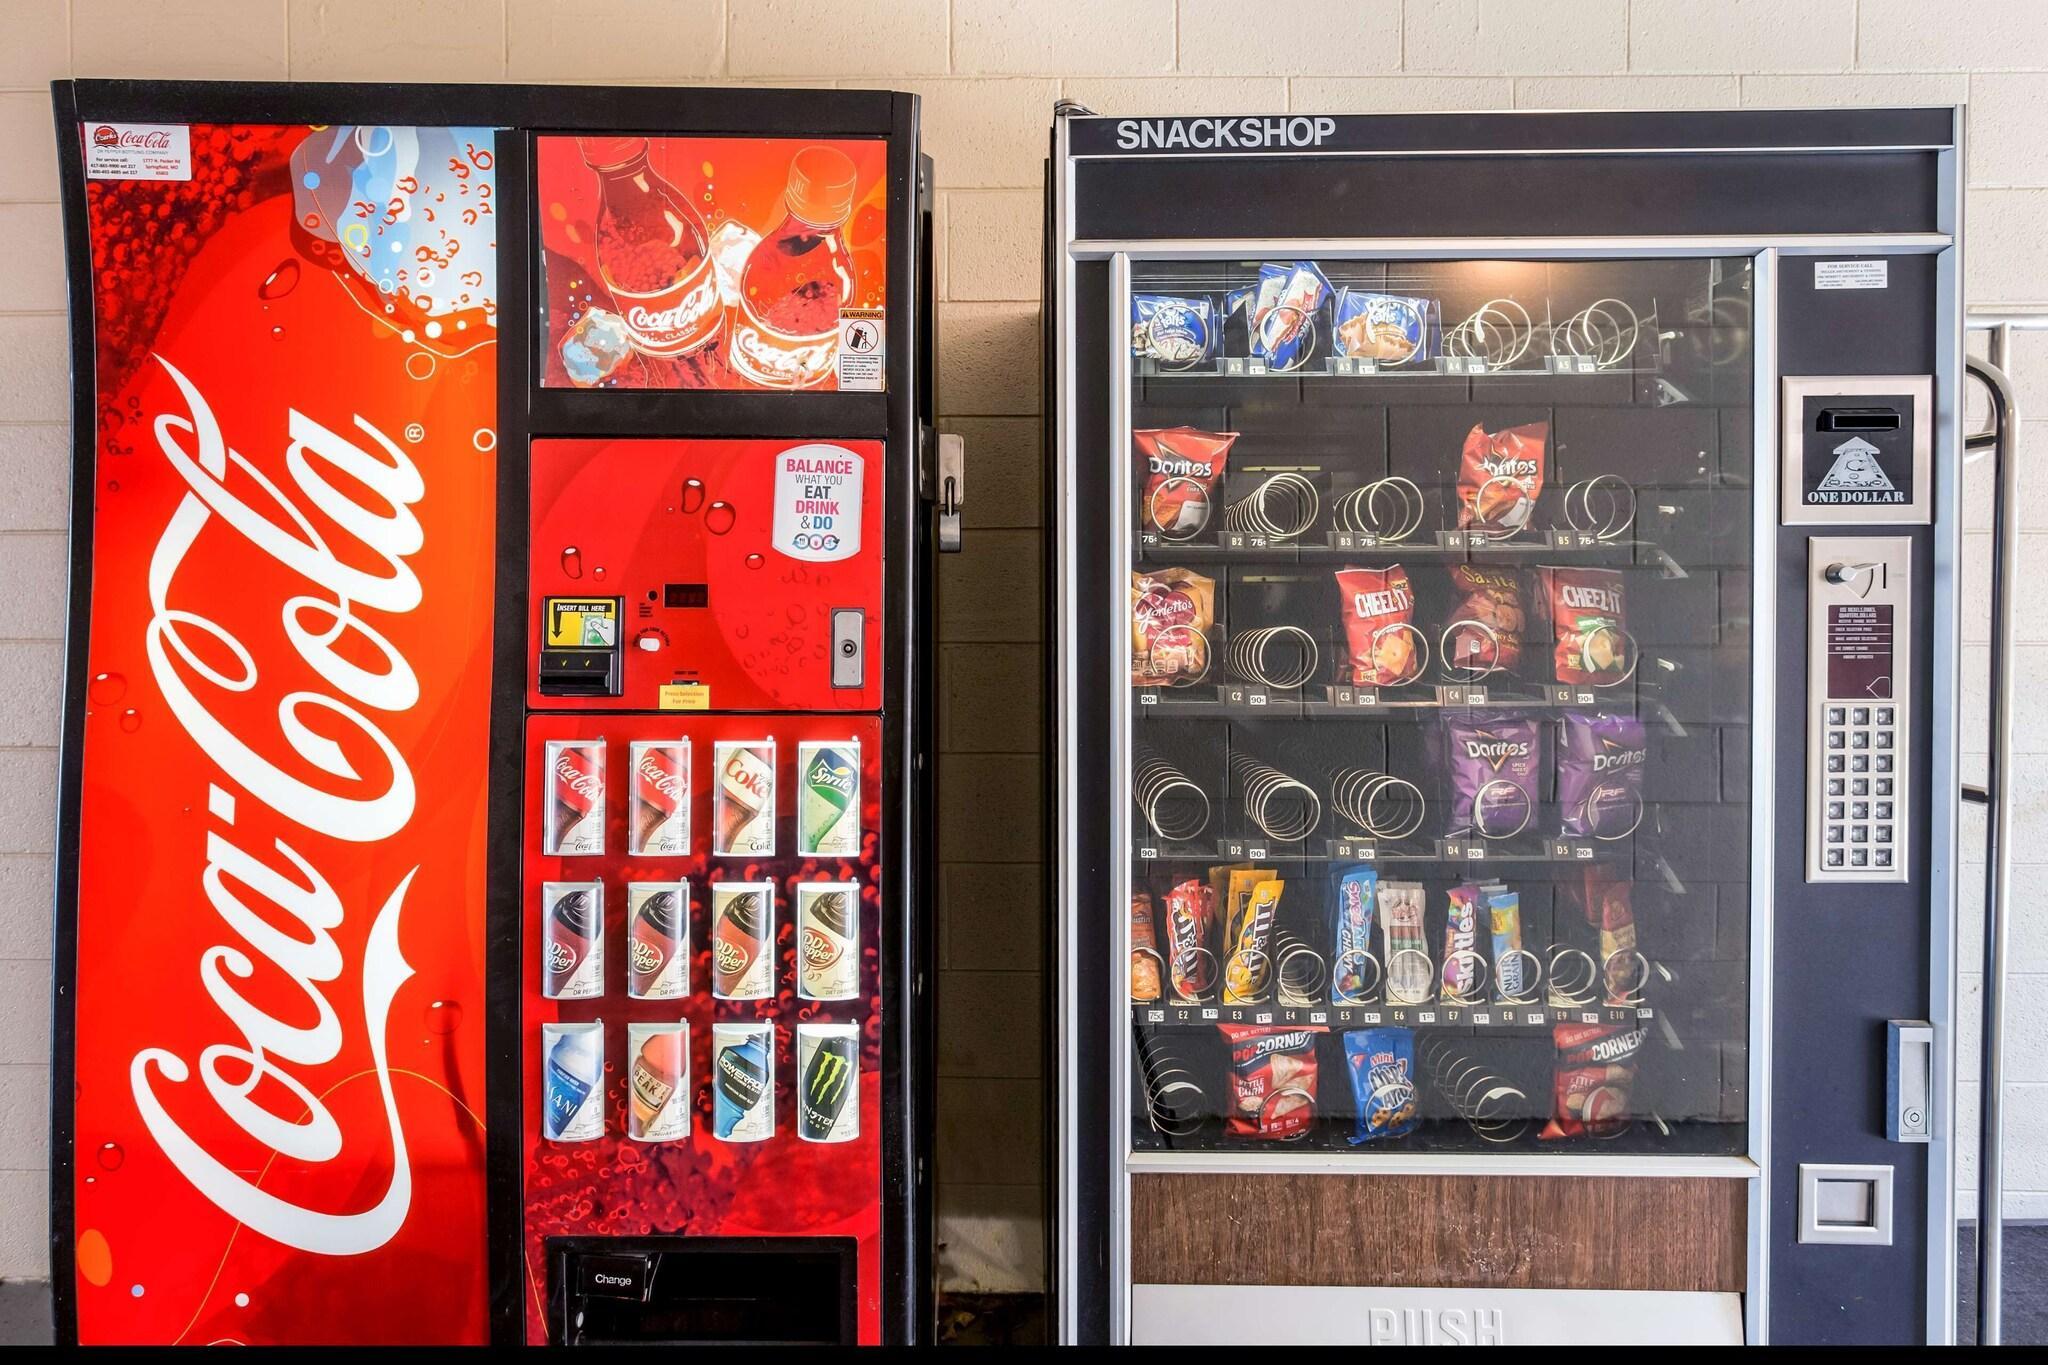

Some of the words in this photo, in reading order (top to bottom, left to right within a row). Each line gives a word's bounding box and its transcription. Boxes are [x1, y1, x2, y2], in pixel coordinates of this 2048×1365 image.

[120, 130, 172, 149] Coca-Cola
[1116, 117, 1336, 150] SNACKSHOP
[786, 459, 853, 474] BALANCE
[1149, 457, 1212, 478] Doritos
[795, 474, 822, 484] WHAT
[824, 475, 843, 485] YOU
[1807, 491, 1839, 503] ONE
[1841, 491, 1905, 503] DOLLAR
[795, 500, 840, 515] DRINK
[801, 516, 811, 530] &
[813, 516, 833, 530] DO
[1466, 741, 1528, 758] Doritos
[726, 758, 769, 799] Coke
[811, 766, 853, 791] Sprite
[130, 352, 426, 1256] Coca-Cola
[1179, 1010, 1189, 1019] E2
[1233, 1010, 1243, 1019] E3
[1286, 1010, 1296, 1020] E4
[1340, 1011, 1350, 1020] E5
[1394, 1011, 1405, 1020] E6
[1448, 1011, 1458, 1020] E7
[1370, 1051, 1395, 1067] Mini
[595, 1273, 632, 1287] Change
[1368, 1308, 1504, 1346] PUSH
